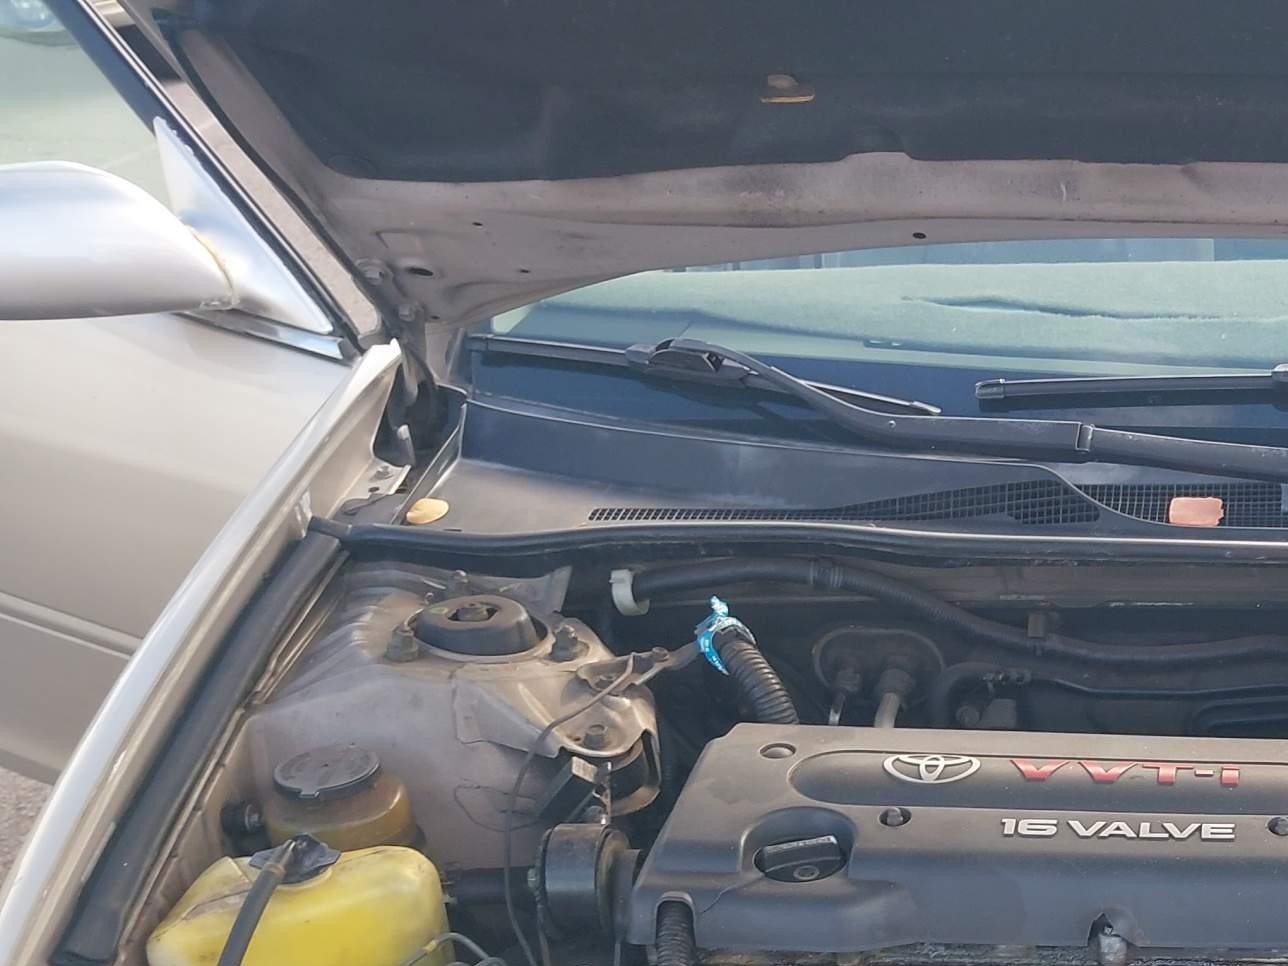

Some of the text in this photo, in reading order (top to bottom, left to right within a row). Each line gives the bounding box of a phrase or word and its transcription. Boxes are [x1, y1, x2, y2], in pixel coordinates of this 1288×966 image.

[1009, 759, 1240, 785] VVT-i
[1001, 818, 1236, 839] 16 VALVE
